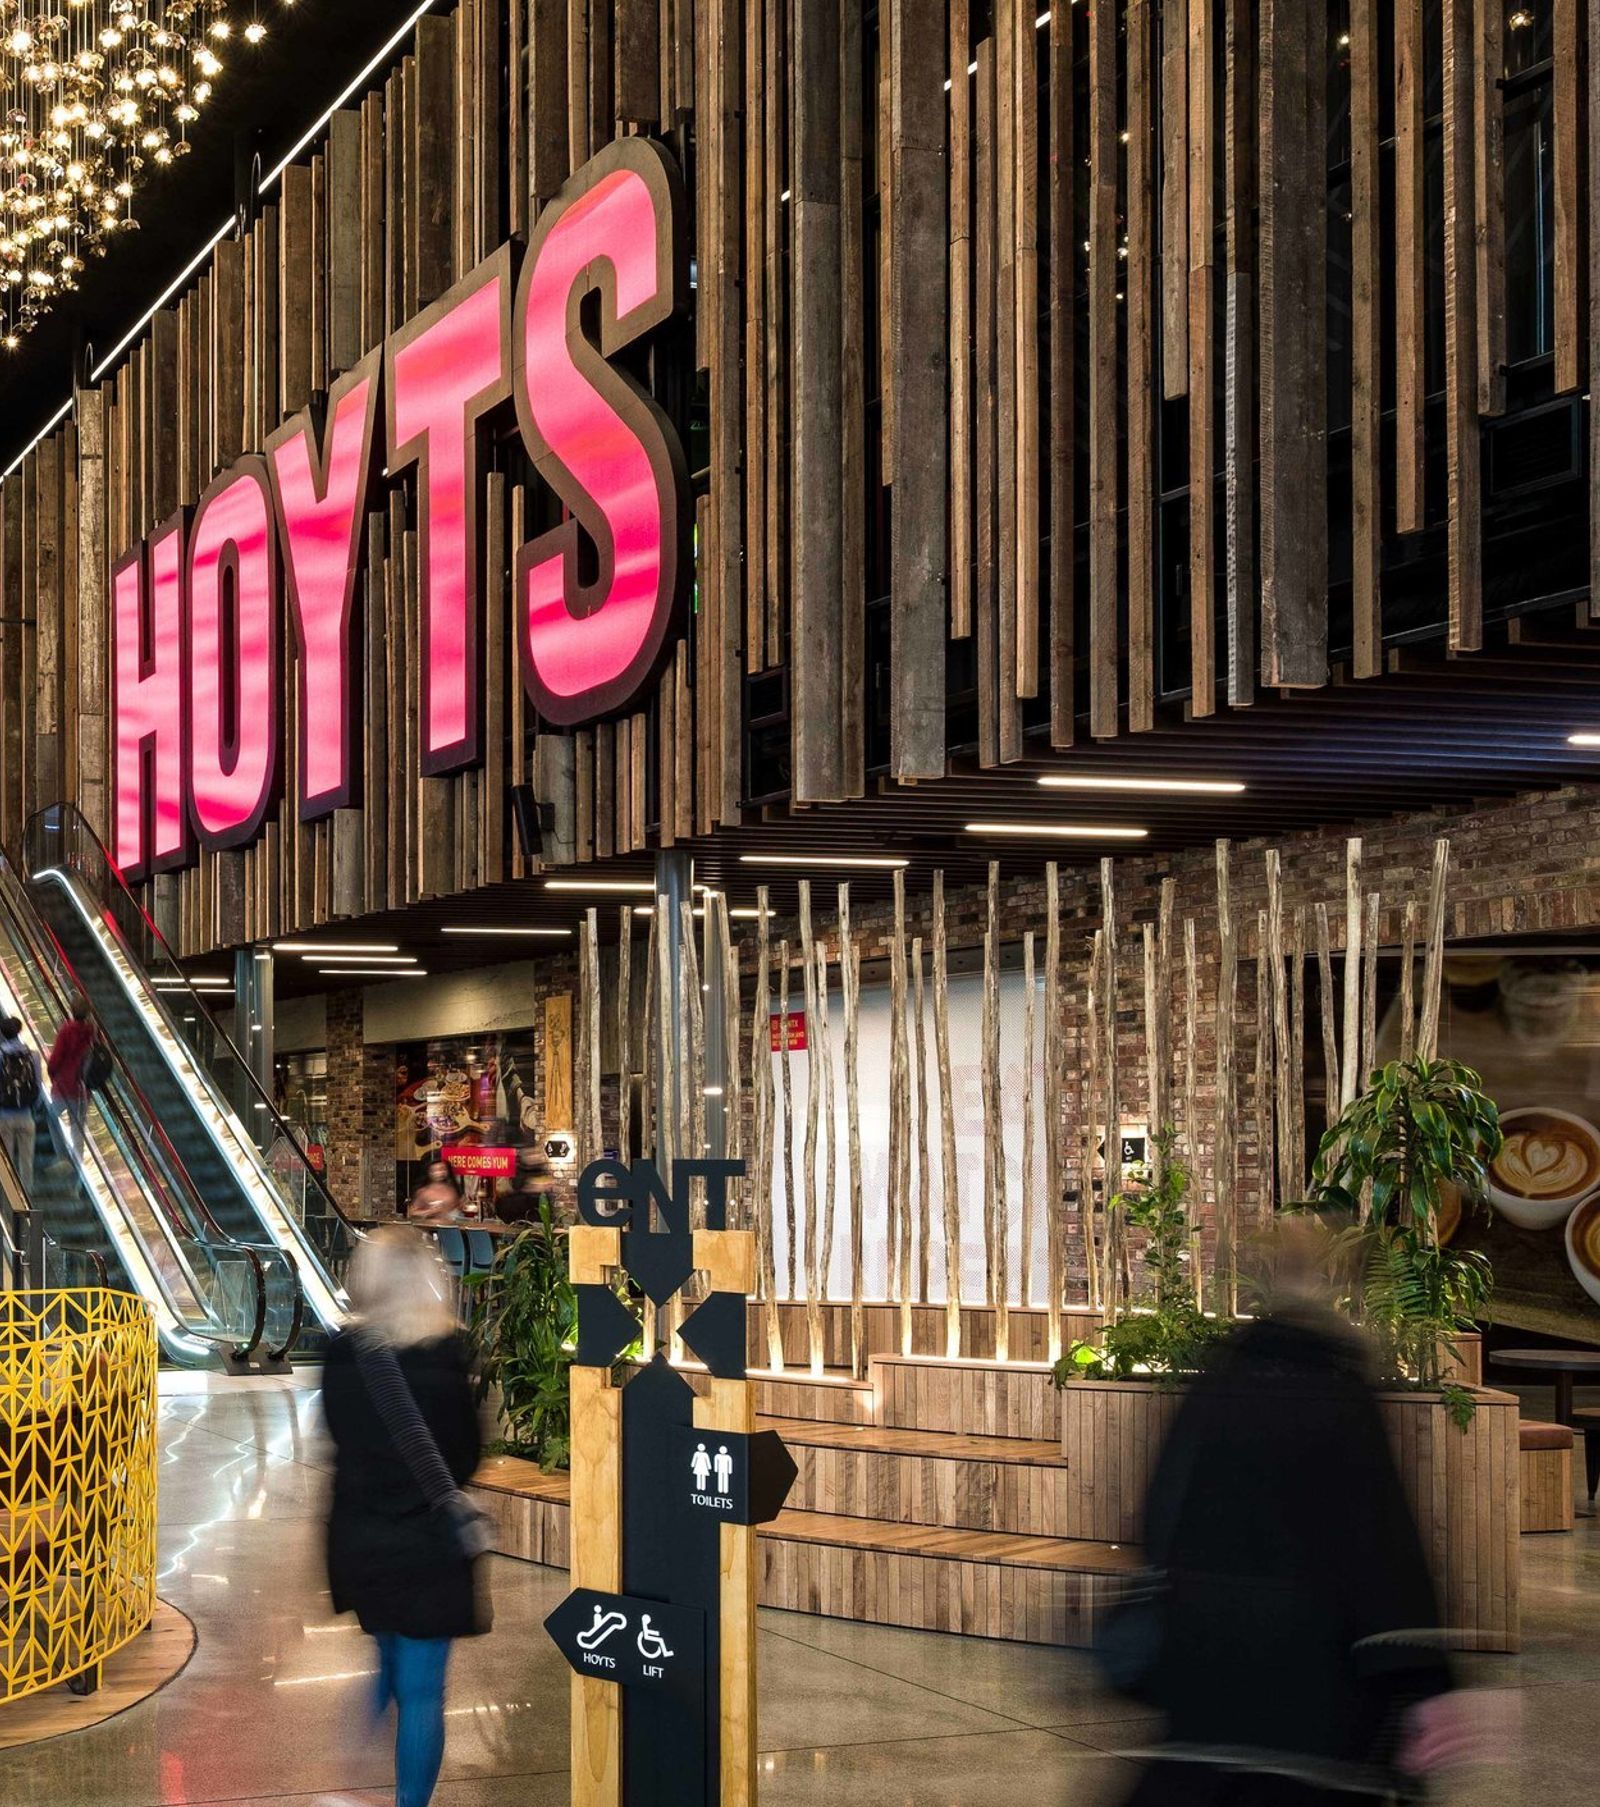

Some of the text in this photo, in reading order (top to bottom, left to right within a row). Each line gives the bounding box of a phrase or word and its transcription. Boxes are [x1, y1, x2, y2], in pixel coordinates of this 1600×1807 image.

[112, 145, 678, 878] HOYTS
[467, 1156, 491, 1169] COMES
[492, 1156, 508, 1169] YUM
[690, 1493, 733, 1510] TOILETS
[583, 1652, 616, 1669] HOYTS
[643, 1664, 664, 1679] LIFT
